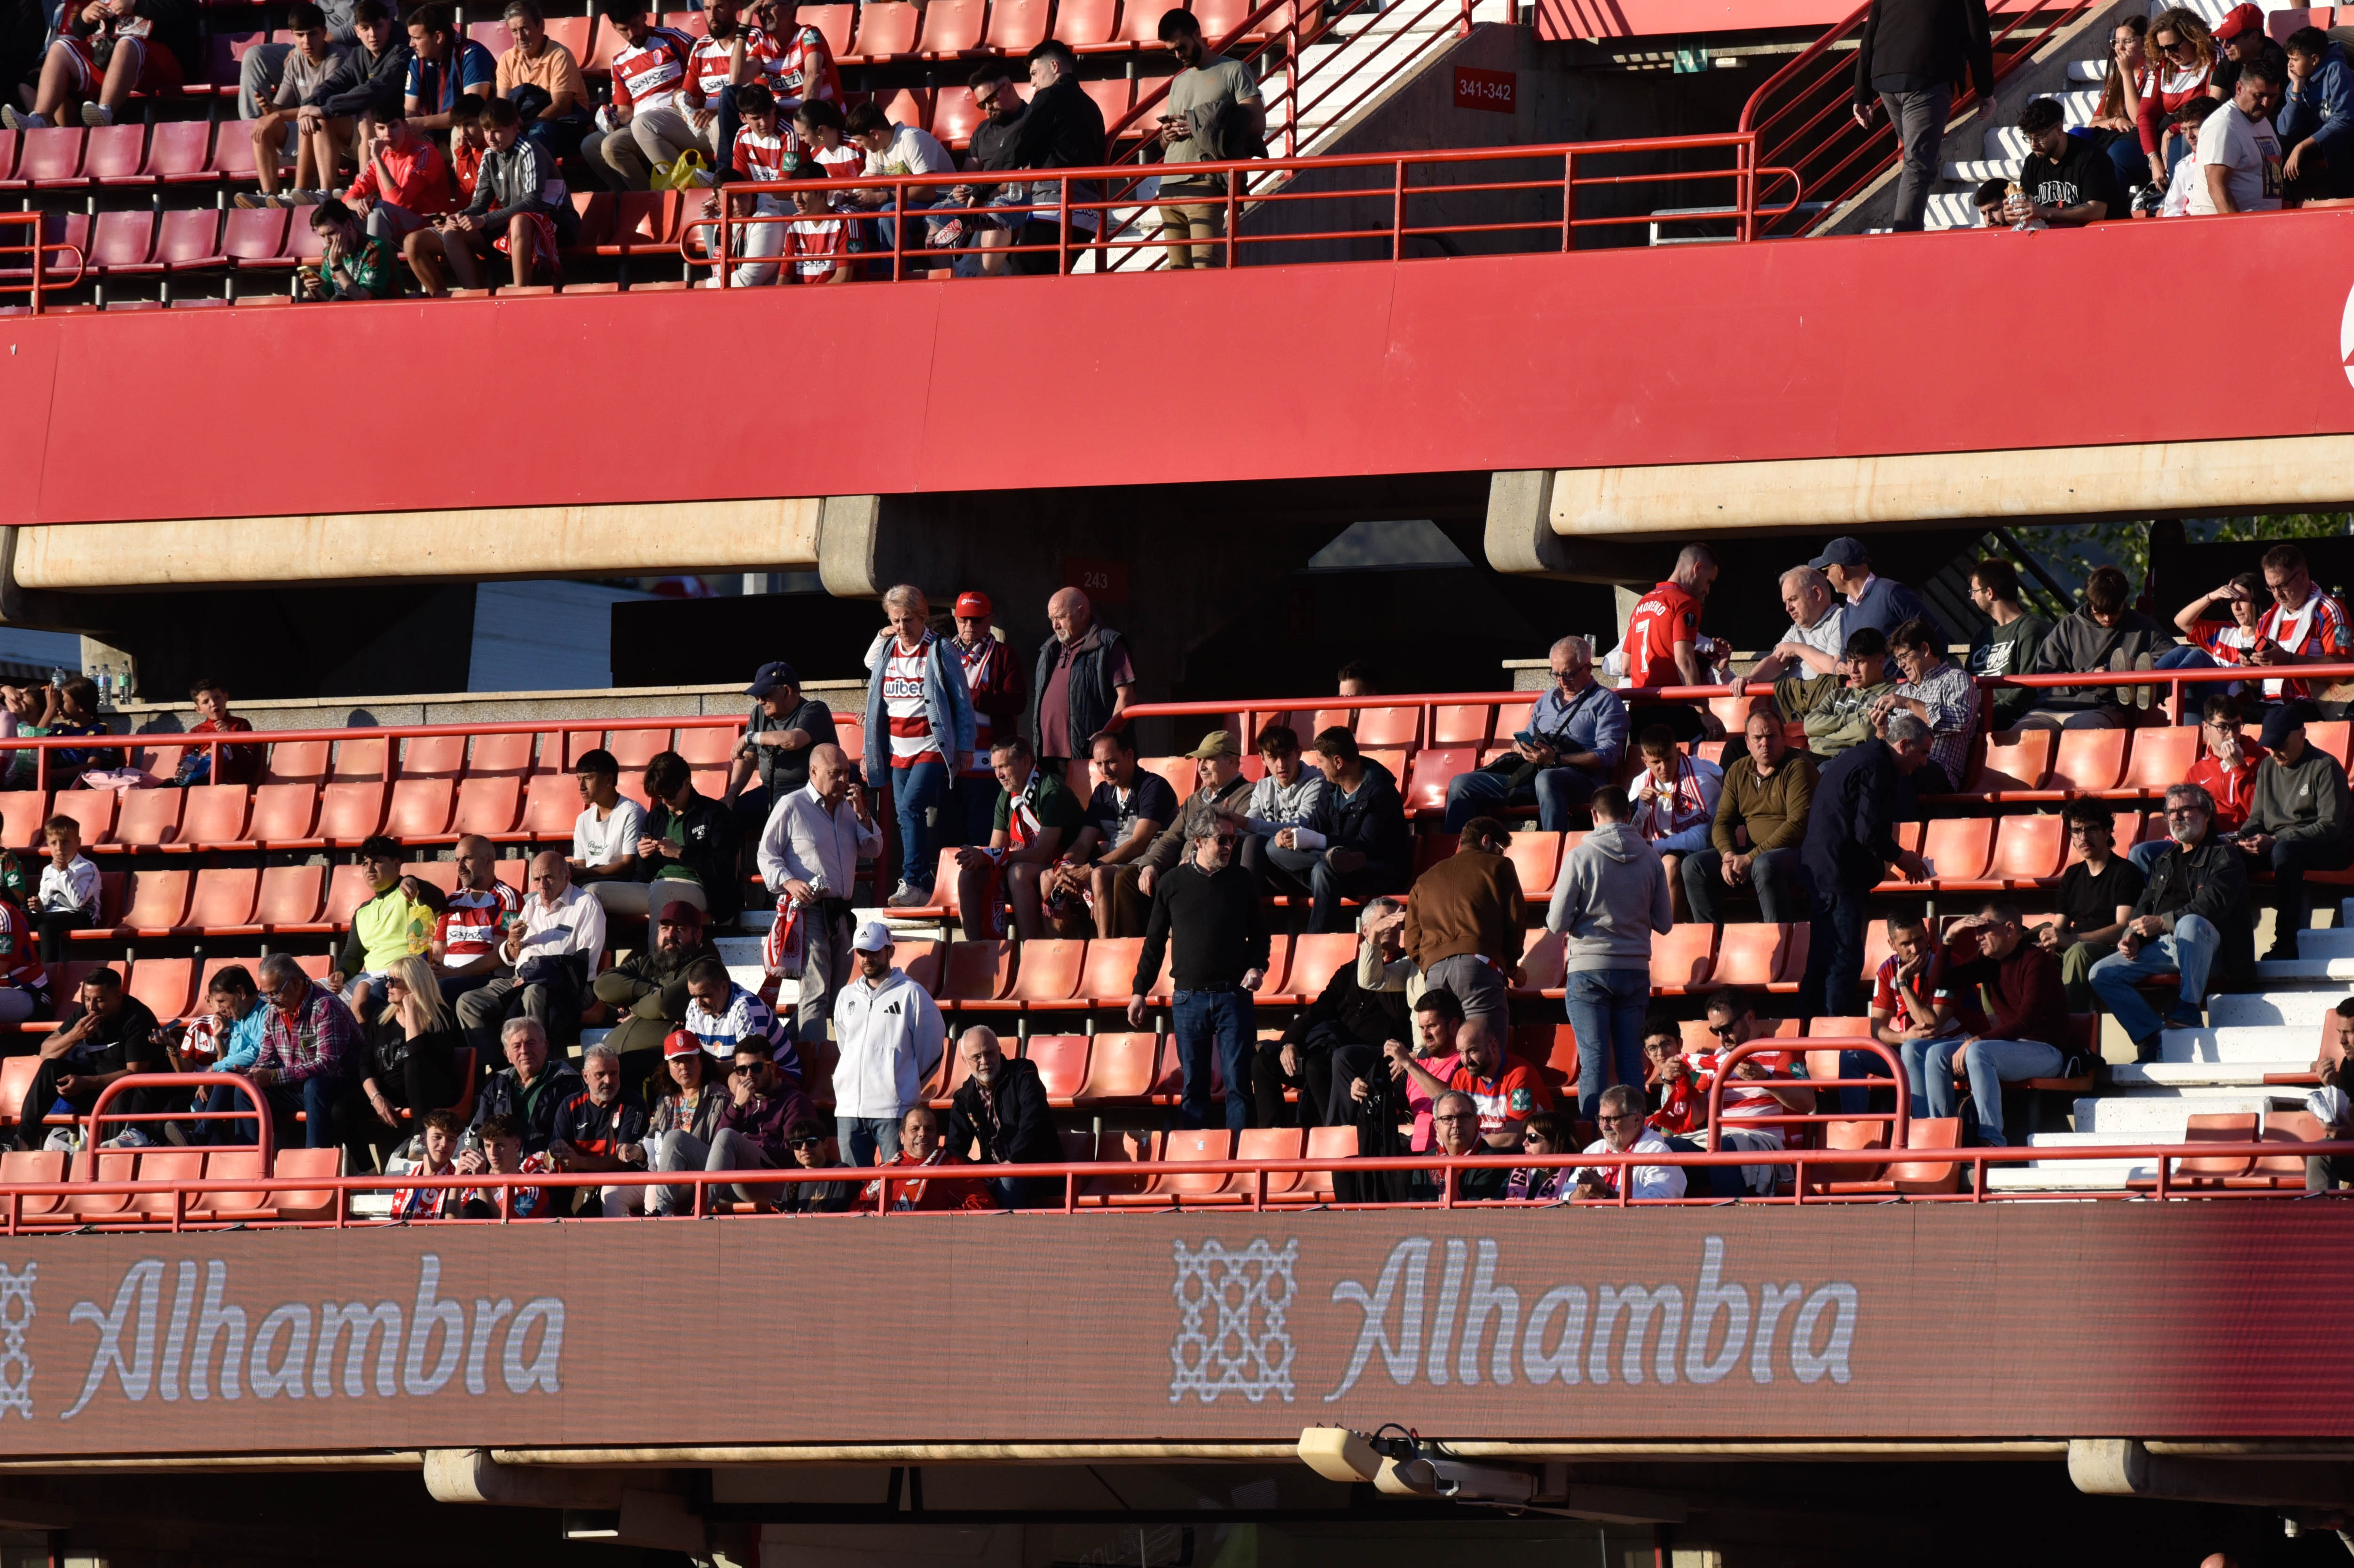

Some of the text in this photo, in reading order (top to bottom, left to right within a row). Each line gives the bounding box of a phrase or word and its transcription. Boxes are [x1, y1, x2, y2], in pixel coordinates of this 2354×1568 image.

[1460, 79, 1511, 101] 341-342
[1084, 571, 1107, 589] 243
[1636, 601, 1666, 616] MORENO
[1636, 619, 1650, 673] 7
[885, 679, 925, 696] wiber
[1324, 1236, 1858, 1402] Alhambra
[61, 1254, 565, 1419] Alhambra
